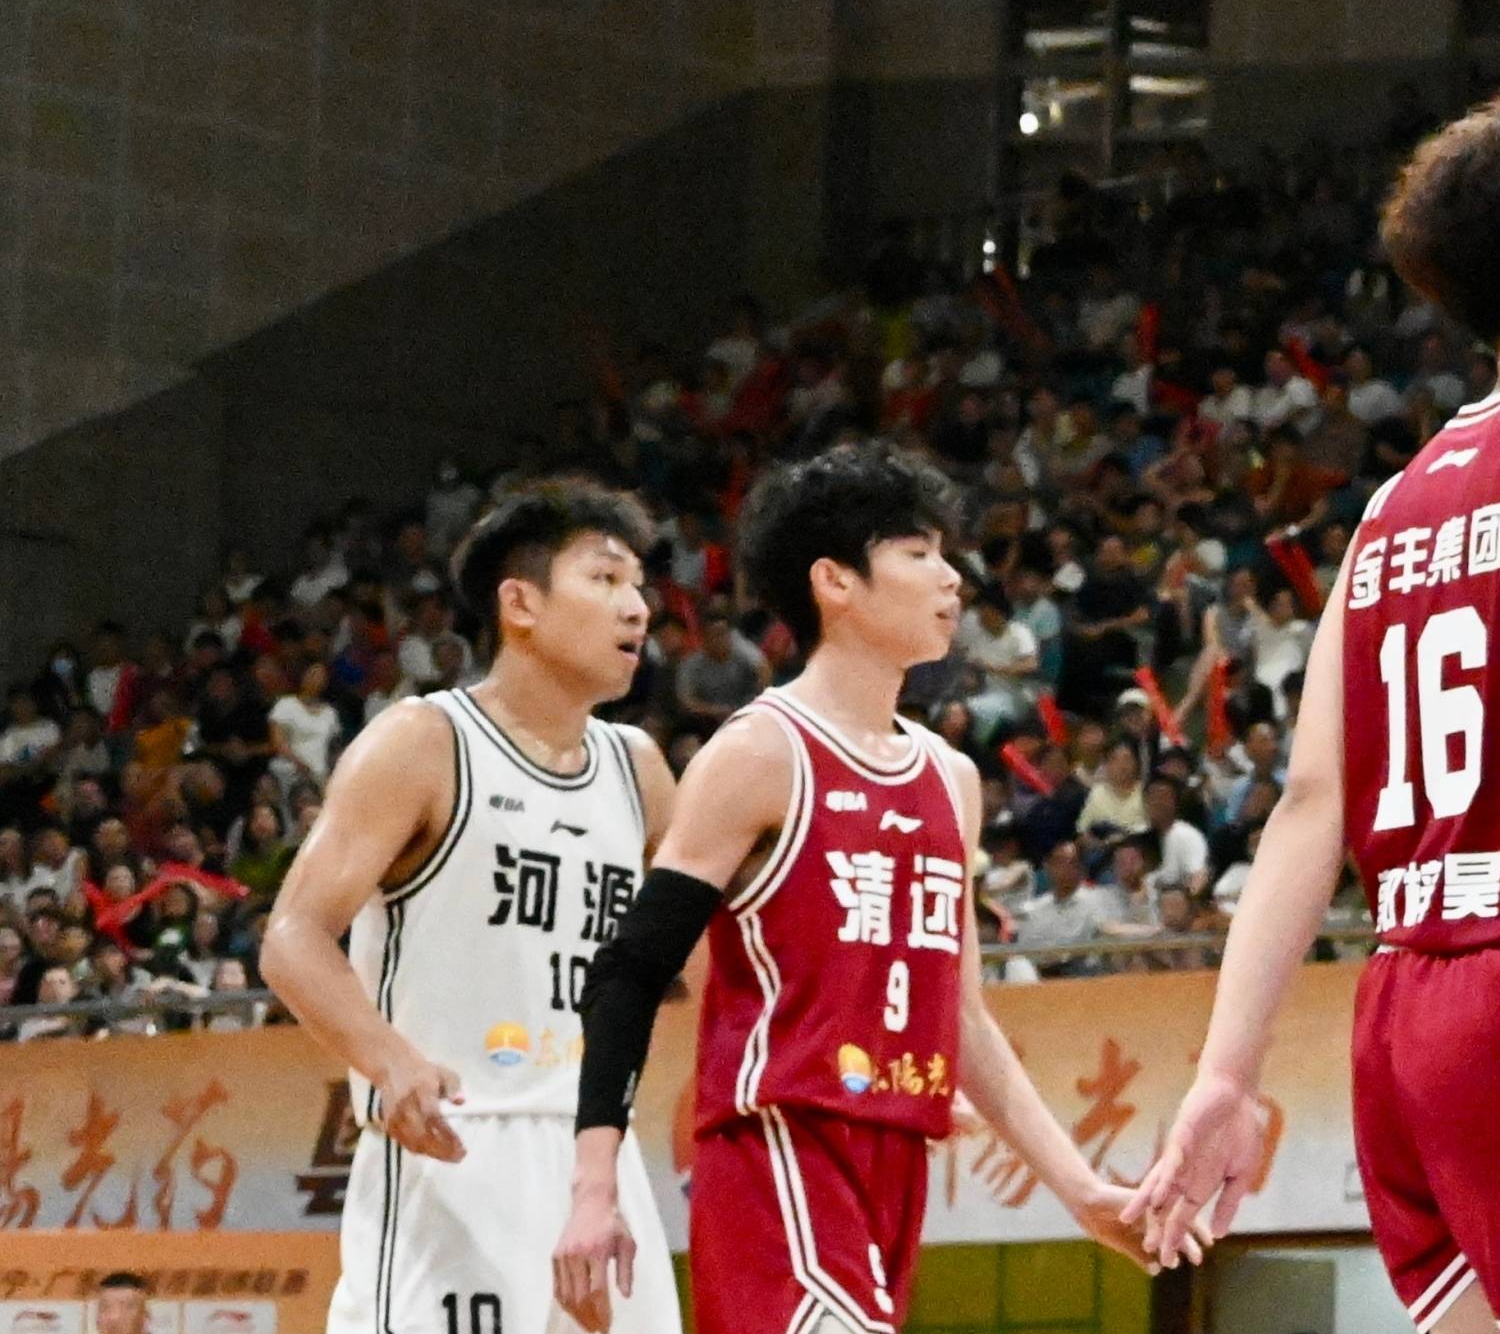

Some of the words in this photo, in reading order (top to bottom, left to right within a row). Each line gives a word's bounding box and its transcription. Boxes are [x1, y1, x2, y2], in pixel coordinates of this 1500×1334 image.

[1373, 606, 1487, 832] 16
[488, 844, 637, 943] 河源
[825, 851, 963, 954] 清远
[550, 951, 592, 1013] 10
[884, 960, 910, 1033] 9
